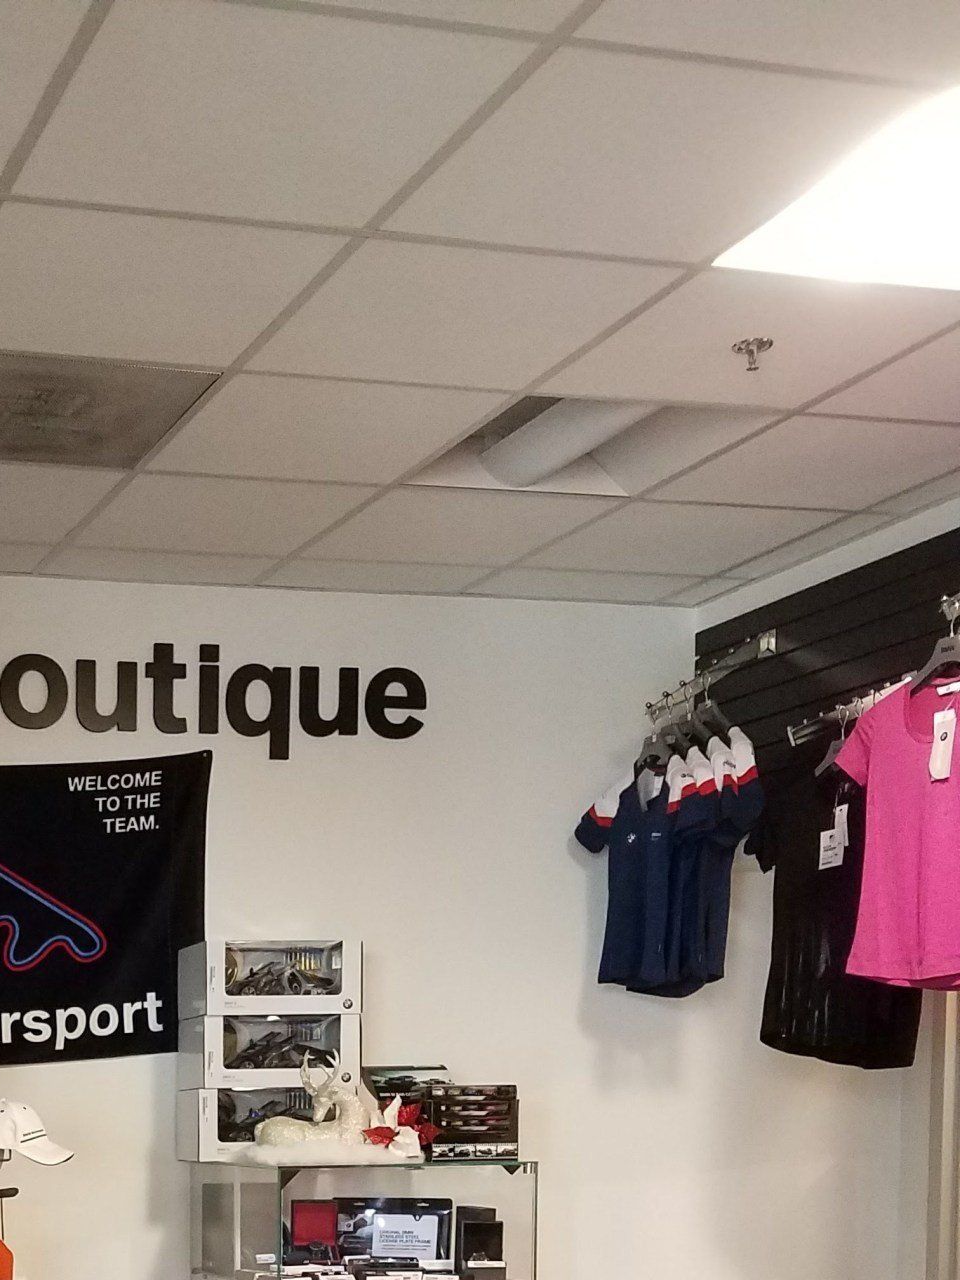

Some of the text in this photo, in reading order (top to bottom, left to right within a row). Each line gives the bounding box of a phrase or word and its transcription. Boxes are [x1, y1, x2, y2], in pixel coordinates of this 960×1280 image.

[68, 771, 162, 791] WELCOME
[94, 792, 161, 812] TO THE
[102, 815, 160, 833] TEAM.
